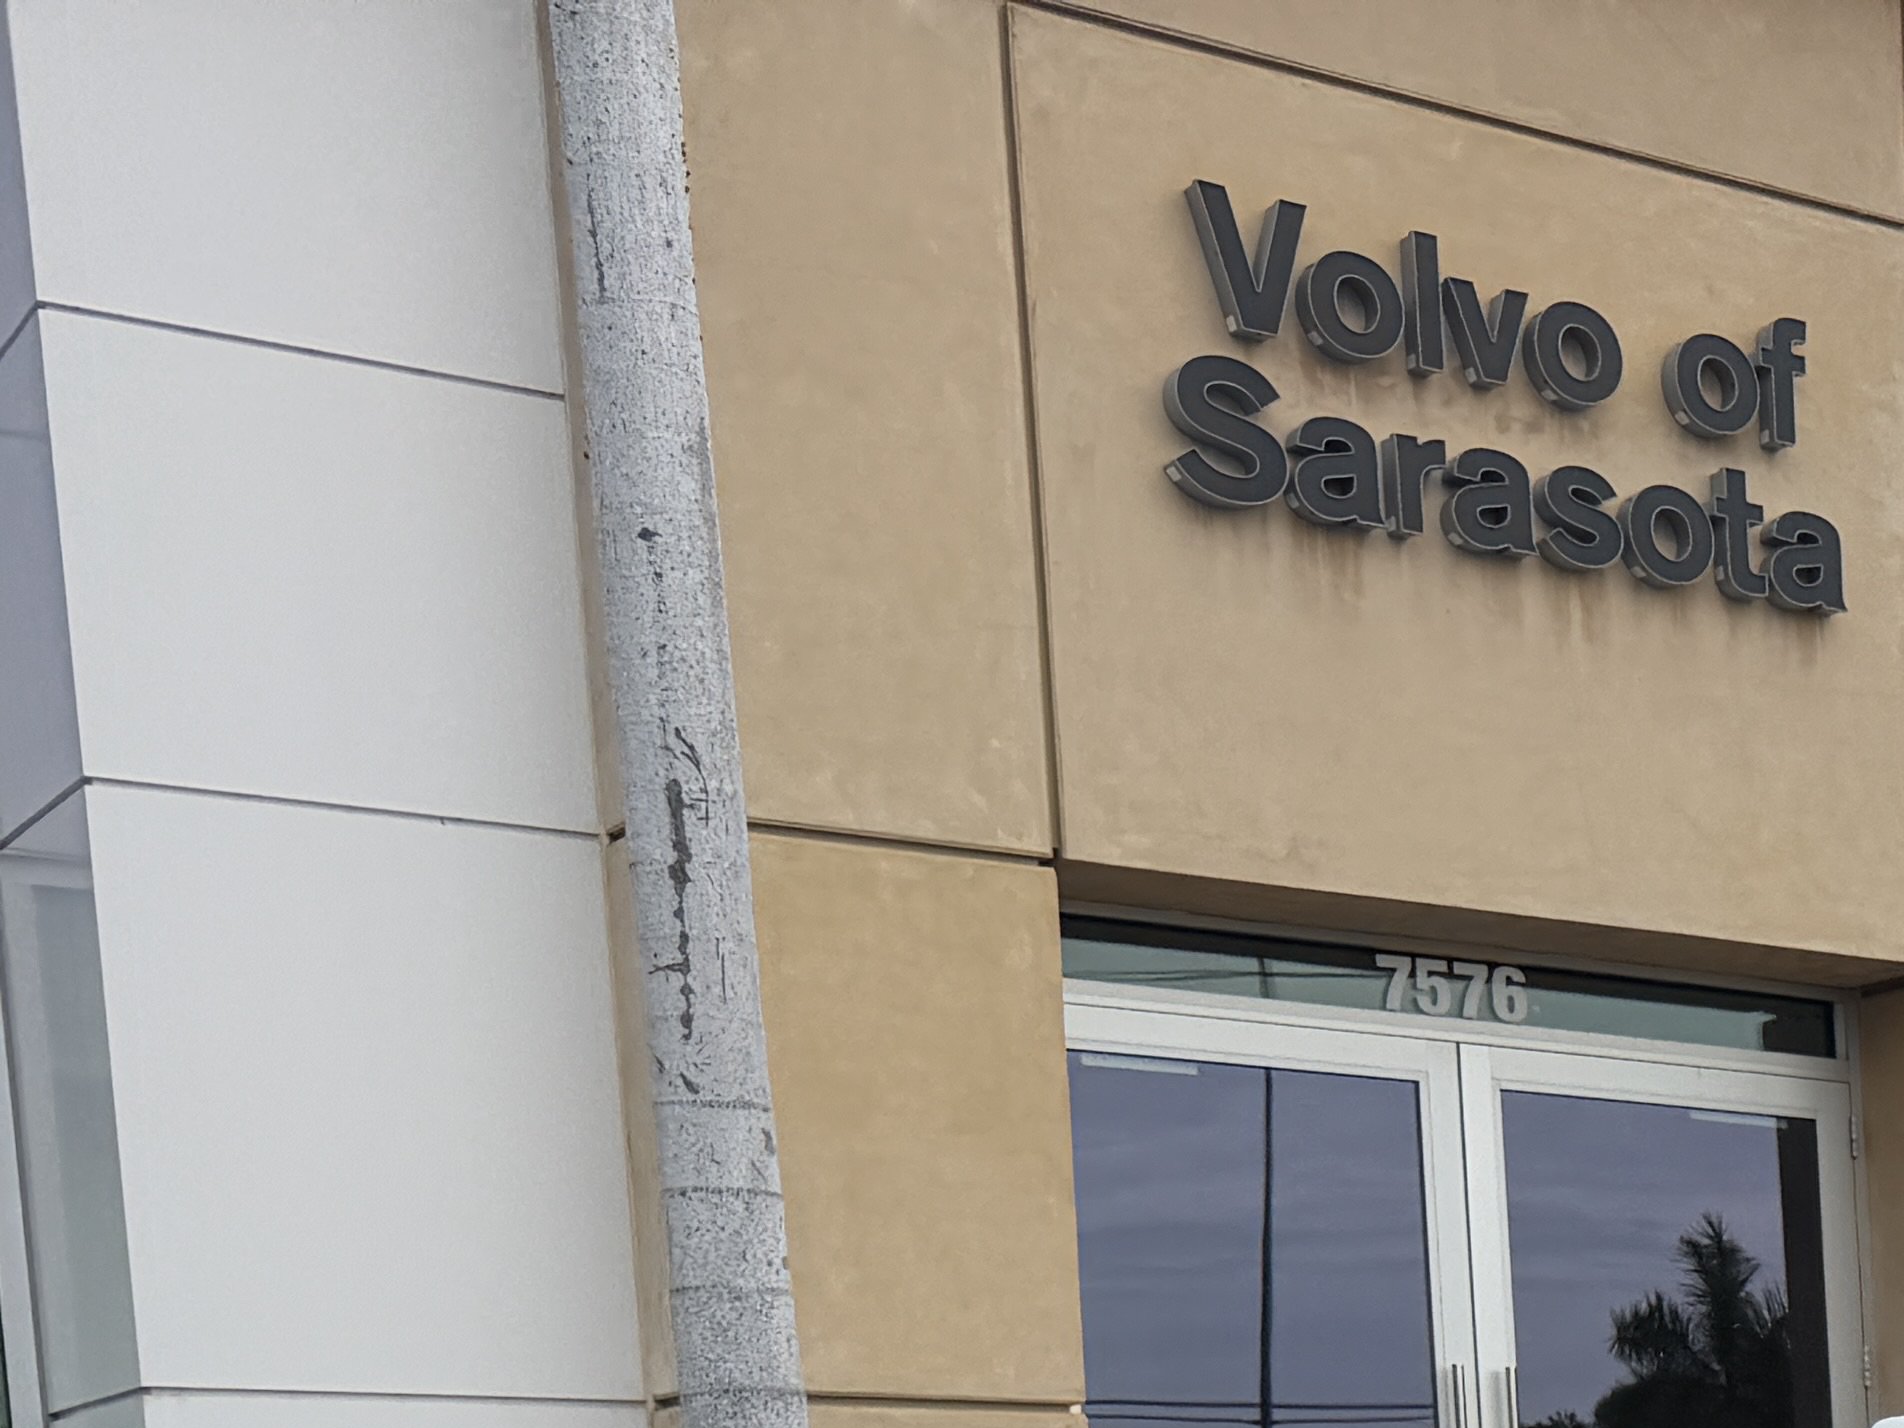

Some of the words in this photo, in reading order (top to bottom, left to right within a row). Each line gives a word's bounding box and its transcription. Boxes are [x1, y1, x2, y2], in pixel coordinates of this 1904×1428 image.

[1185, 179, 1623, 411] Volvo
[1662, 316, 1807, 452] of
[1163, 355, 1847, 617] Sarasota
[1375, 953, 1530, 1024] 7576
